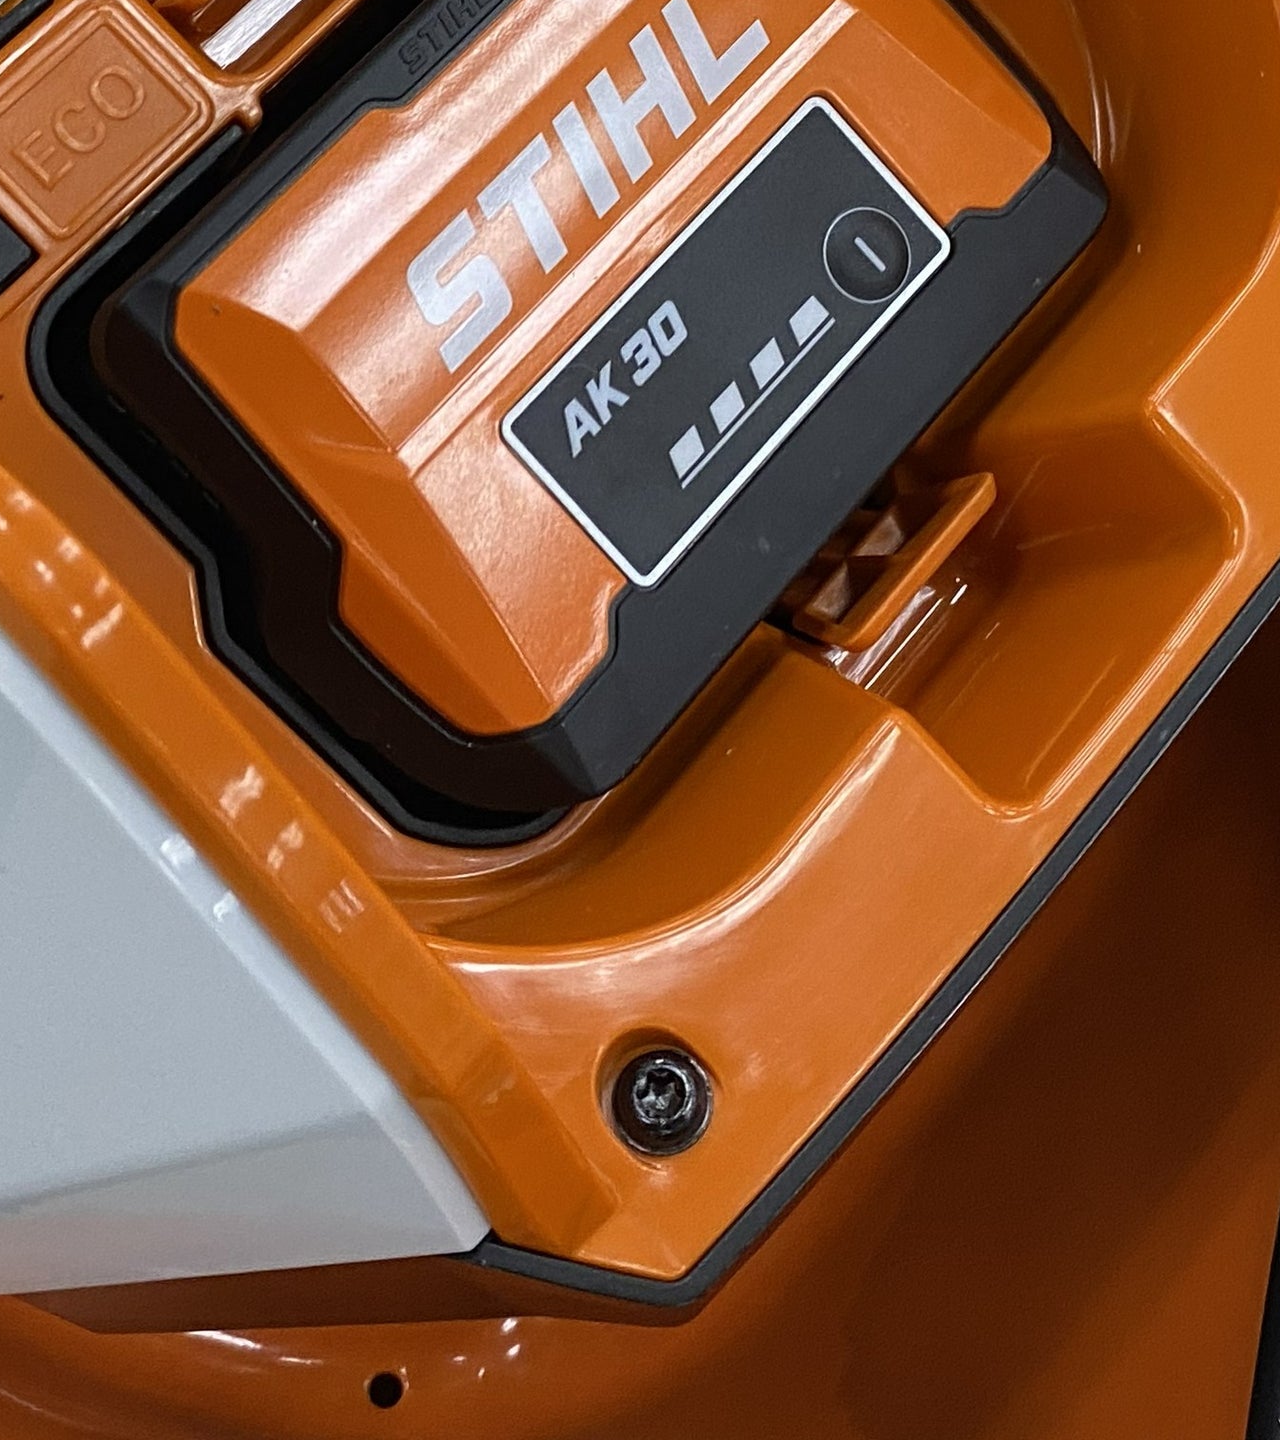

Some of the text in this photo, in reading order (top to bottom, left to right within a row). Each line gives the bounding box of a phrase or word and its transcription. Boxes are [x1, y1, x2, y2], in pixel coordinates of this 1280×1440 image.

[10, 63, 146, 194] ECO
[564, 300, 688, 458] AK 30
